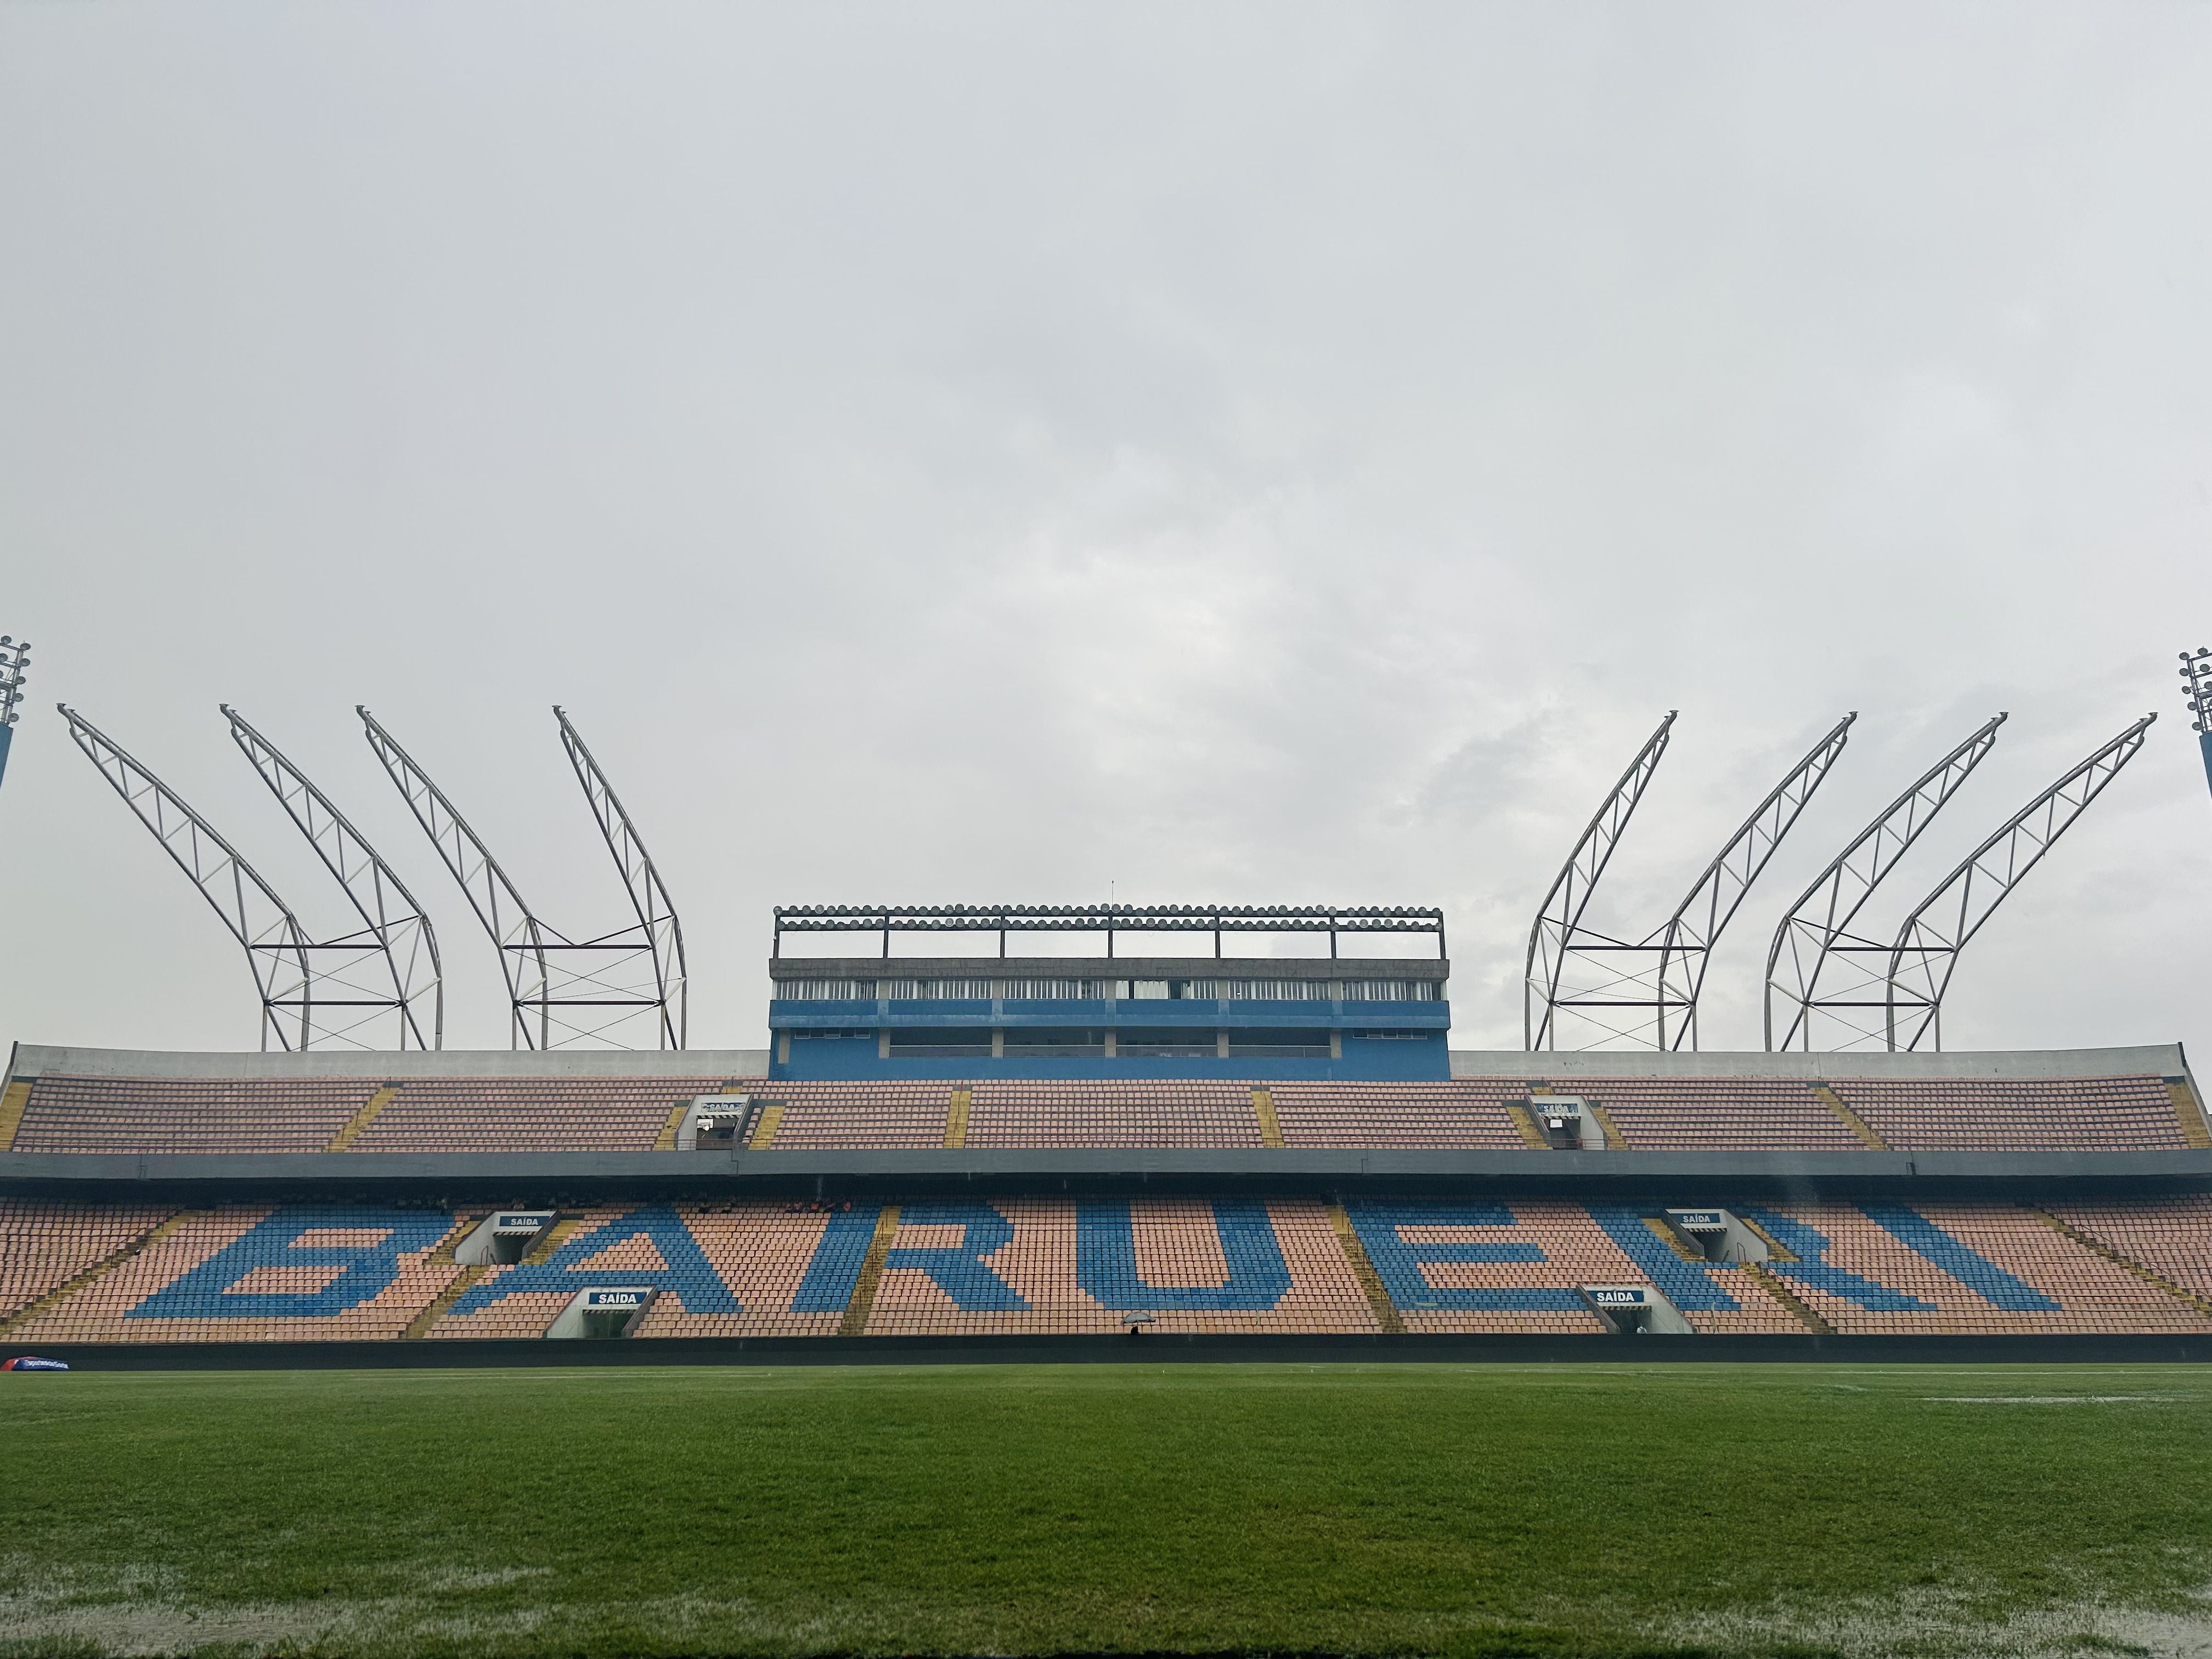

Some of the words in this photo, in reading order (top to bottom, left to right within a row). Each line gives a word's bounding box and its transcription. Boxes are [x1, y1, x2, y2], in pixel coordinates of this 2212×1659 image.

[511, 1217, 538, 1226] SAÍDA
[1683, 1214, 1711, 1223] SAÍDA
[124, 1196, 2062, 1318] BARUERI
[599, 1293, 636, 1304] SAÍDA
[1596, 1290, 1635, 1302] SAÍDA
